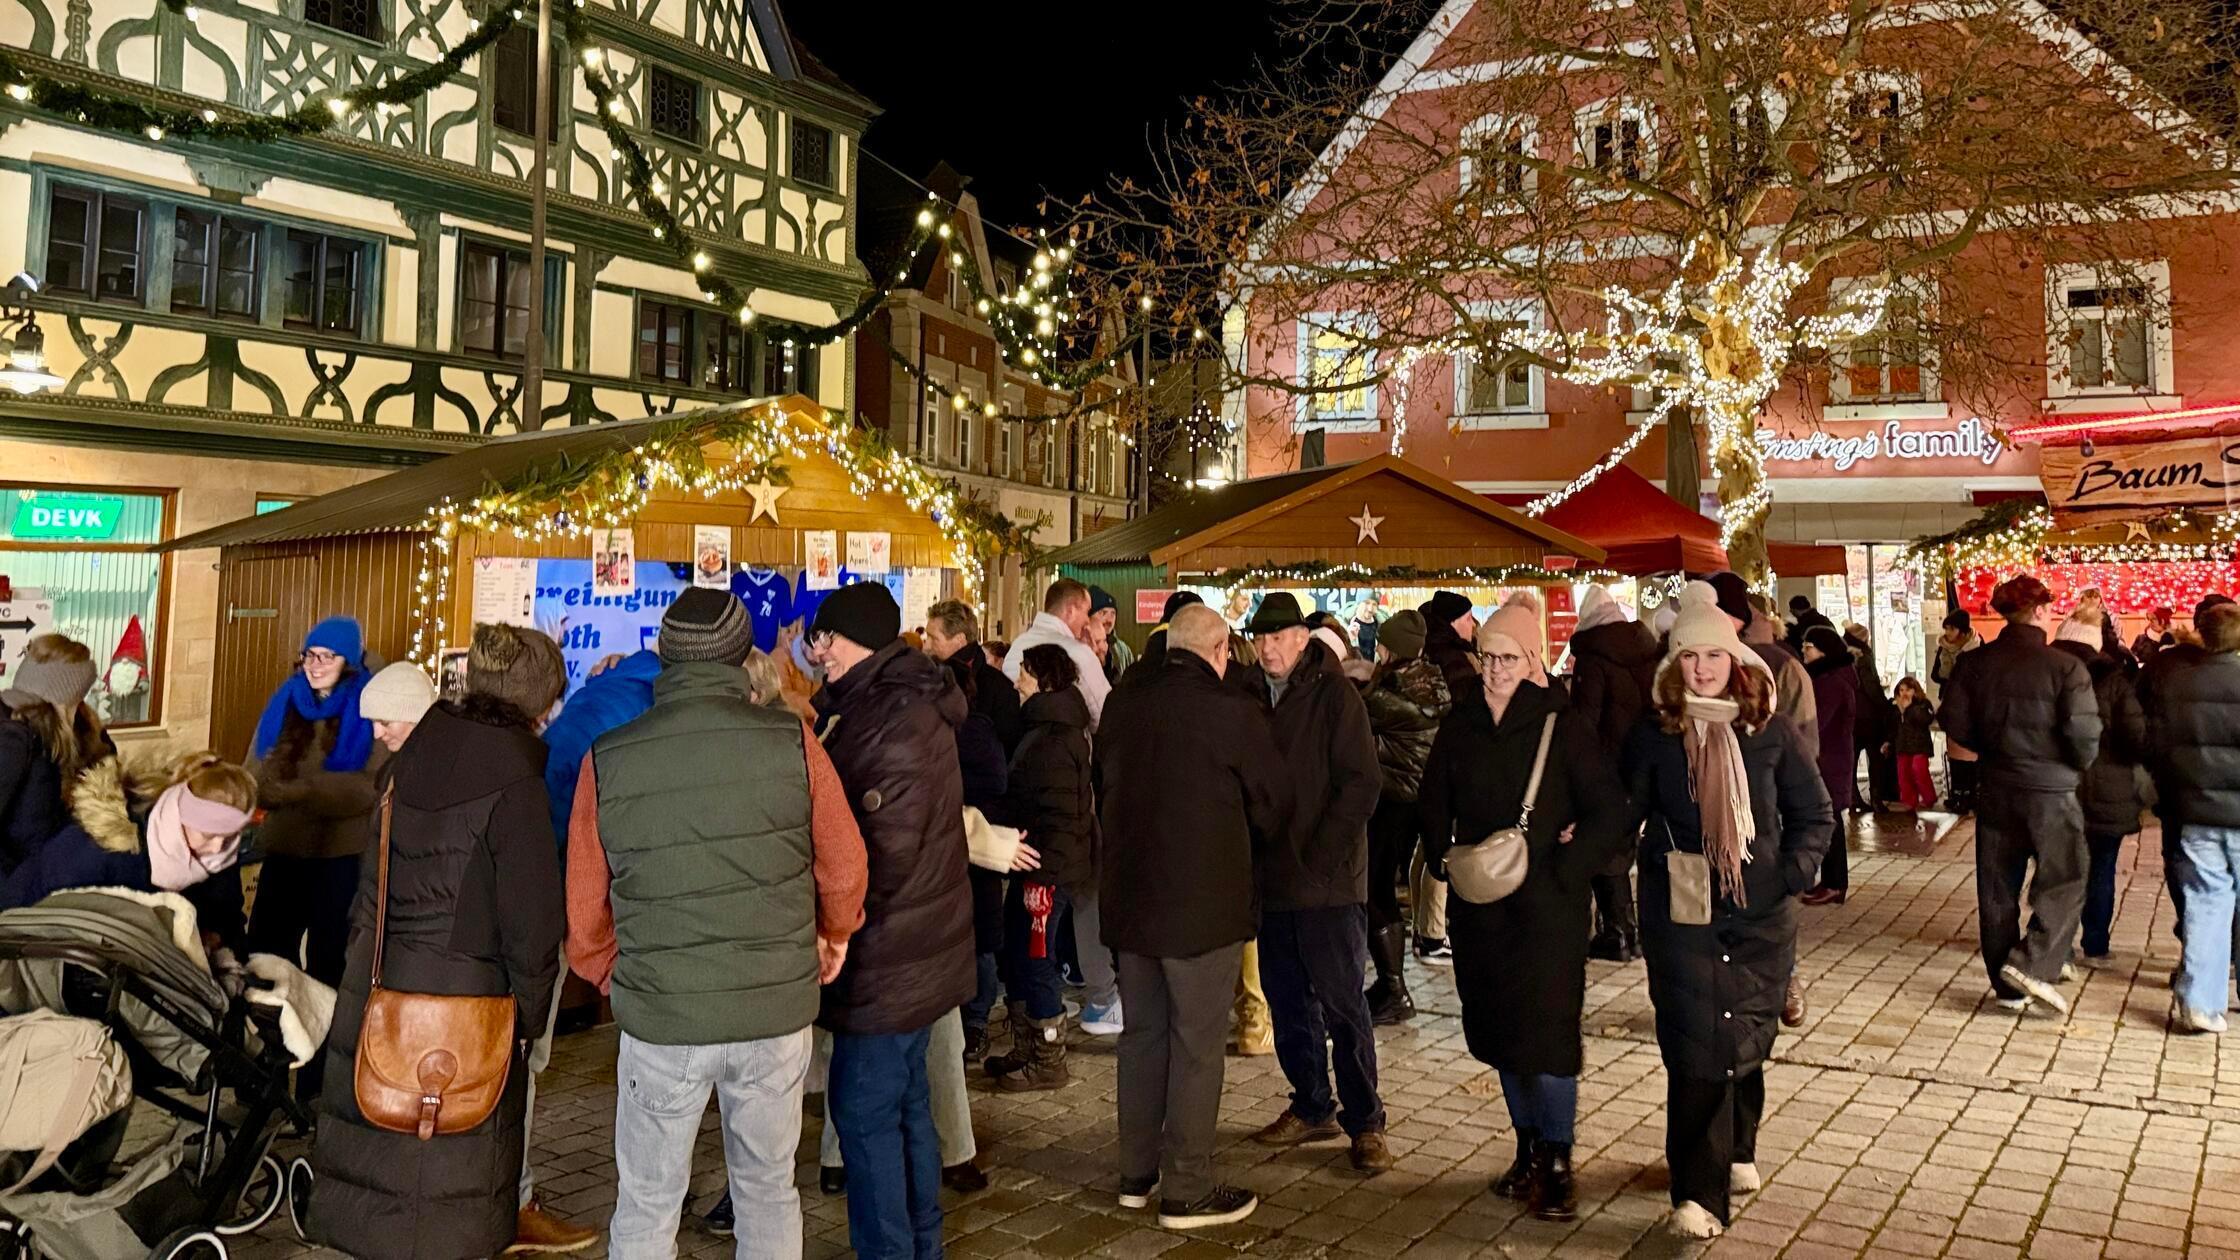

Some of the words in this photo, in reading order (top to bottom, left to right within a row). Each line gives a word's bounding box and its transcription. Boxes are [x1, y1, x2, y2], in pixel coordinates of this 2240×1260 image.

[1885, 419, 2003, 464] family
[31, 508, 103, 528] DEVK
[1362, 518, 1373, 531] 10
